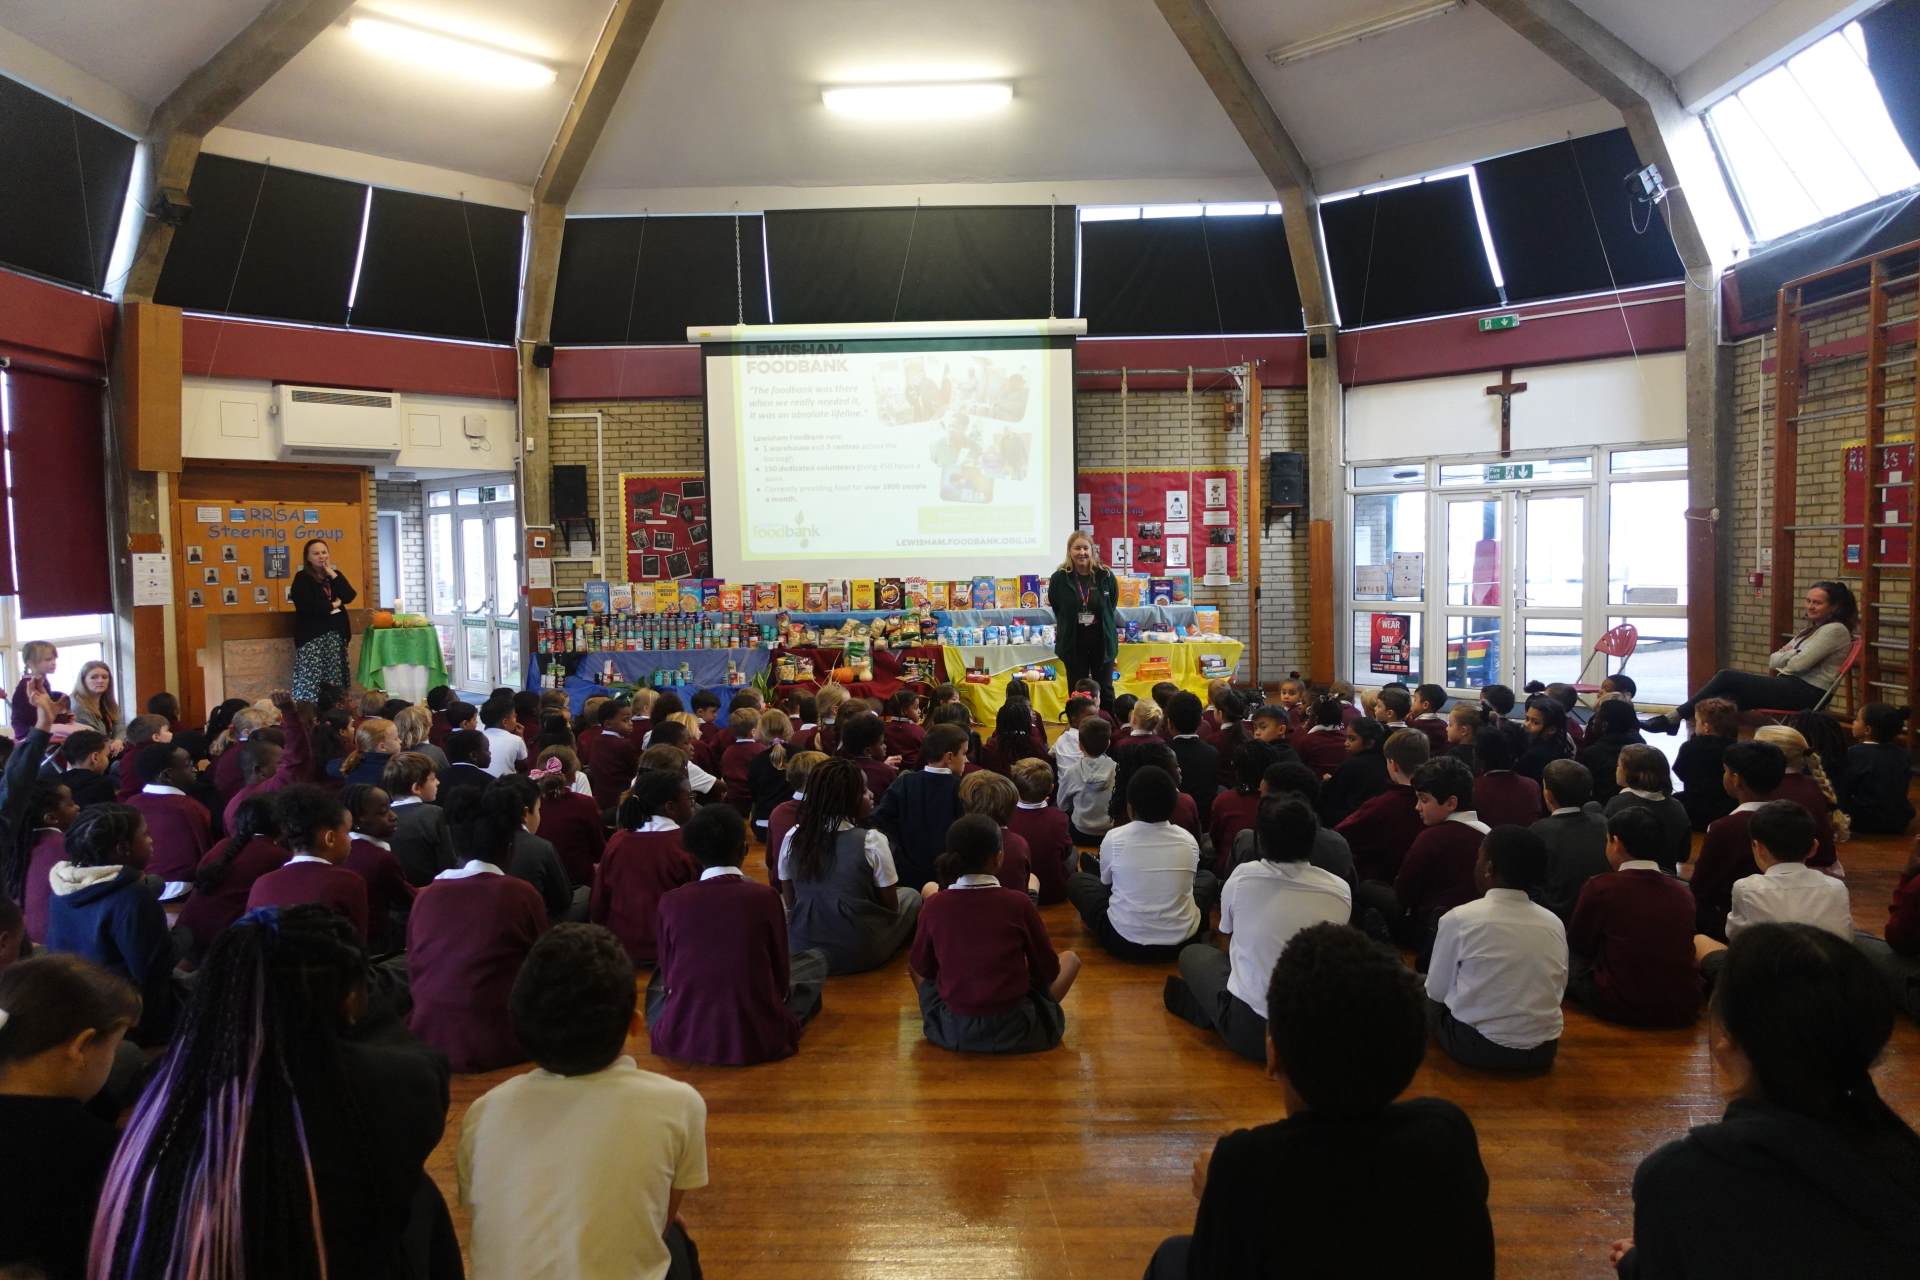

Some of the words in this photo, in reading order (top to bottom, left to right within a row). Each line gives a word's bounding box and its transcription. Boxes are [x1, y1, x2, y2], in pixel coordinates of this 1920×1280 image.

[745, 343, 844, 356] LEWISHAM
[746, 359, 849, 375] FOODBANK
[250, 508, 301, 522] RRSA
[207, 525, 286, 542] Steering
[295, 525, 344, 542] Group
[752, 523, 823, 539] foodbank
[1382, 620, 1401, 629] WEAR
[1381, 635, 1394, 643] DAY
